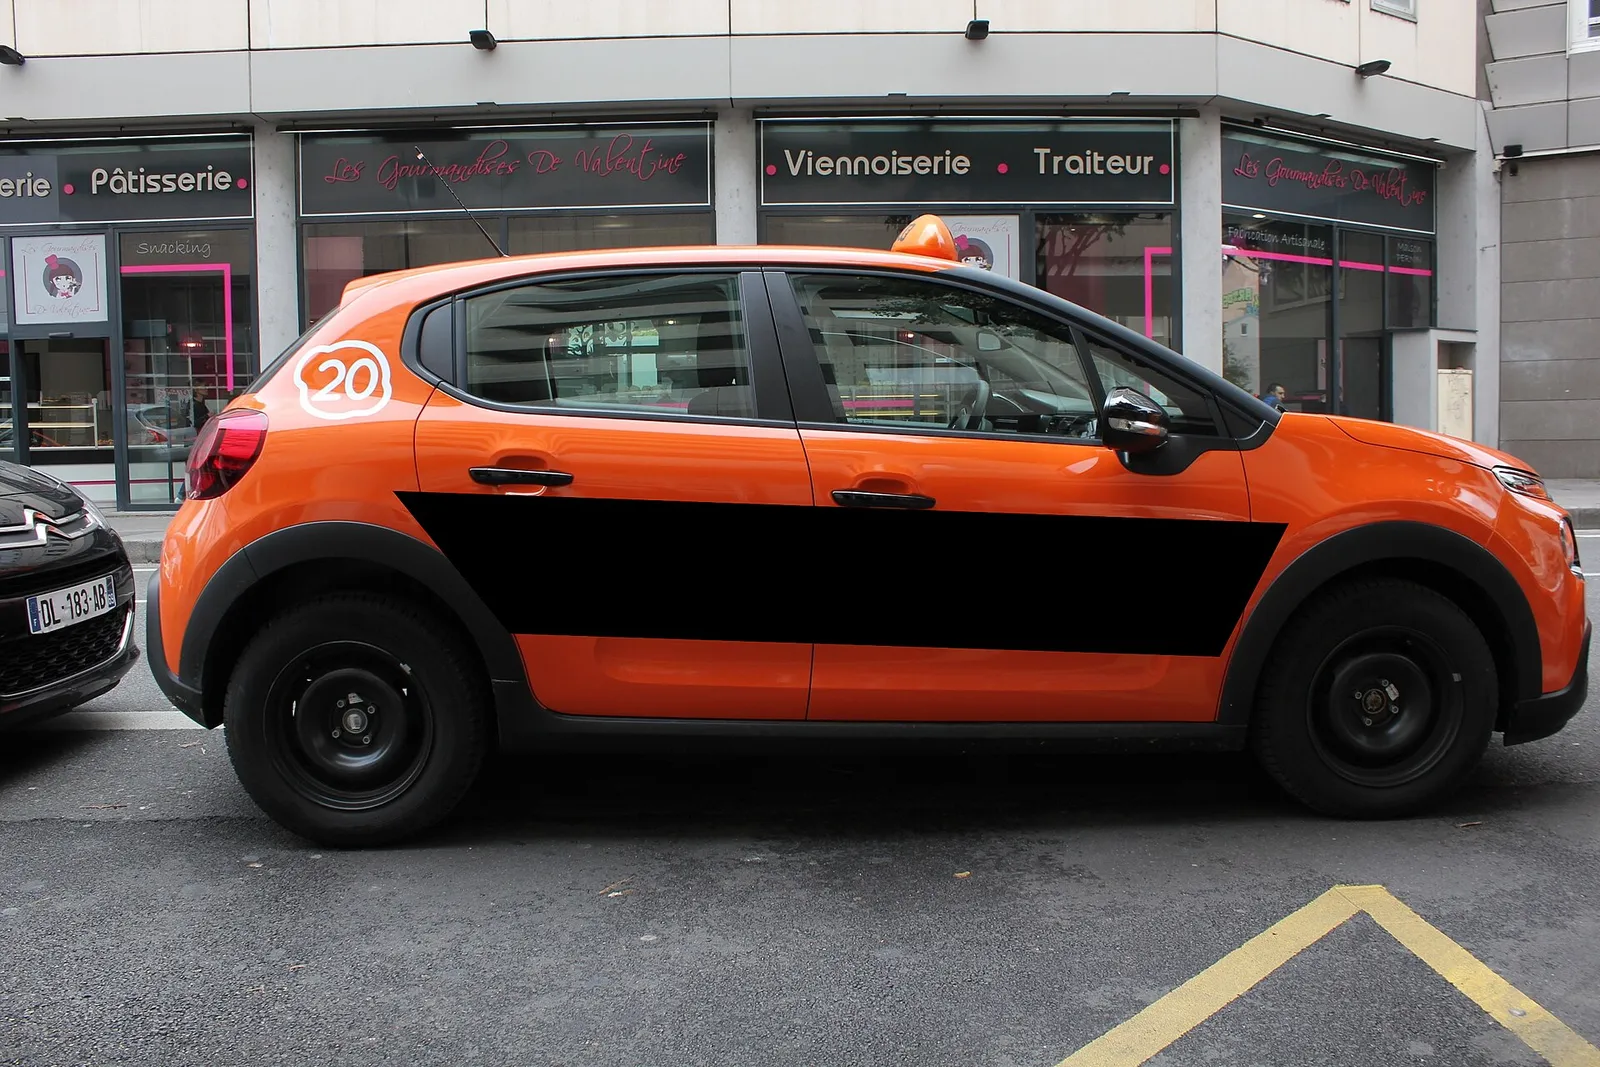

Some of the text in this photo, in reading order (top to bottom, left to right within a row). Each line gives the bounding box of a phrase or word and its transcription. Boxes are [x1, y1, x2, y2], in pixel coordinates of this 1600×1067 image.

[324, 132, 688, 190] Les Gourmandises De Valentine
[784, 149, 971, 176] Viennoiserie
[1034, 147, 1154, 176] Traiteur
[0, 172, 51, 197] erie
[91, 165, 233, 195] Pâtisserie
[1233, 153, 1427, 207] Les Gourmandises De Valentine
[136, 240, 212, 258] Snacking
[311, 358, 378, 401] 20
